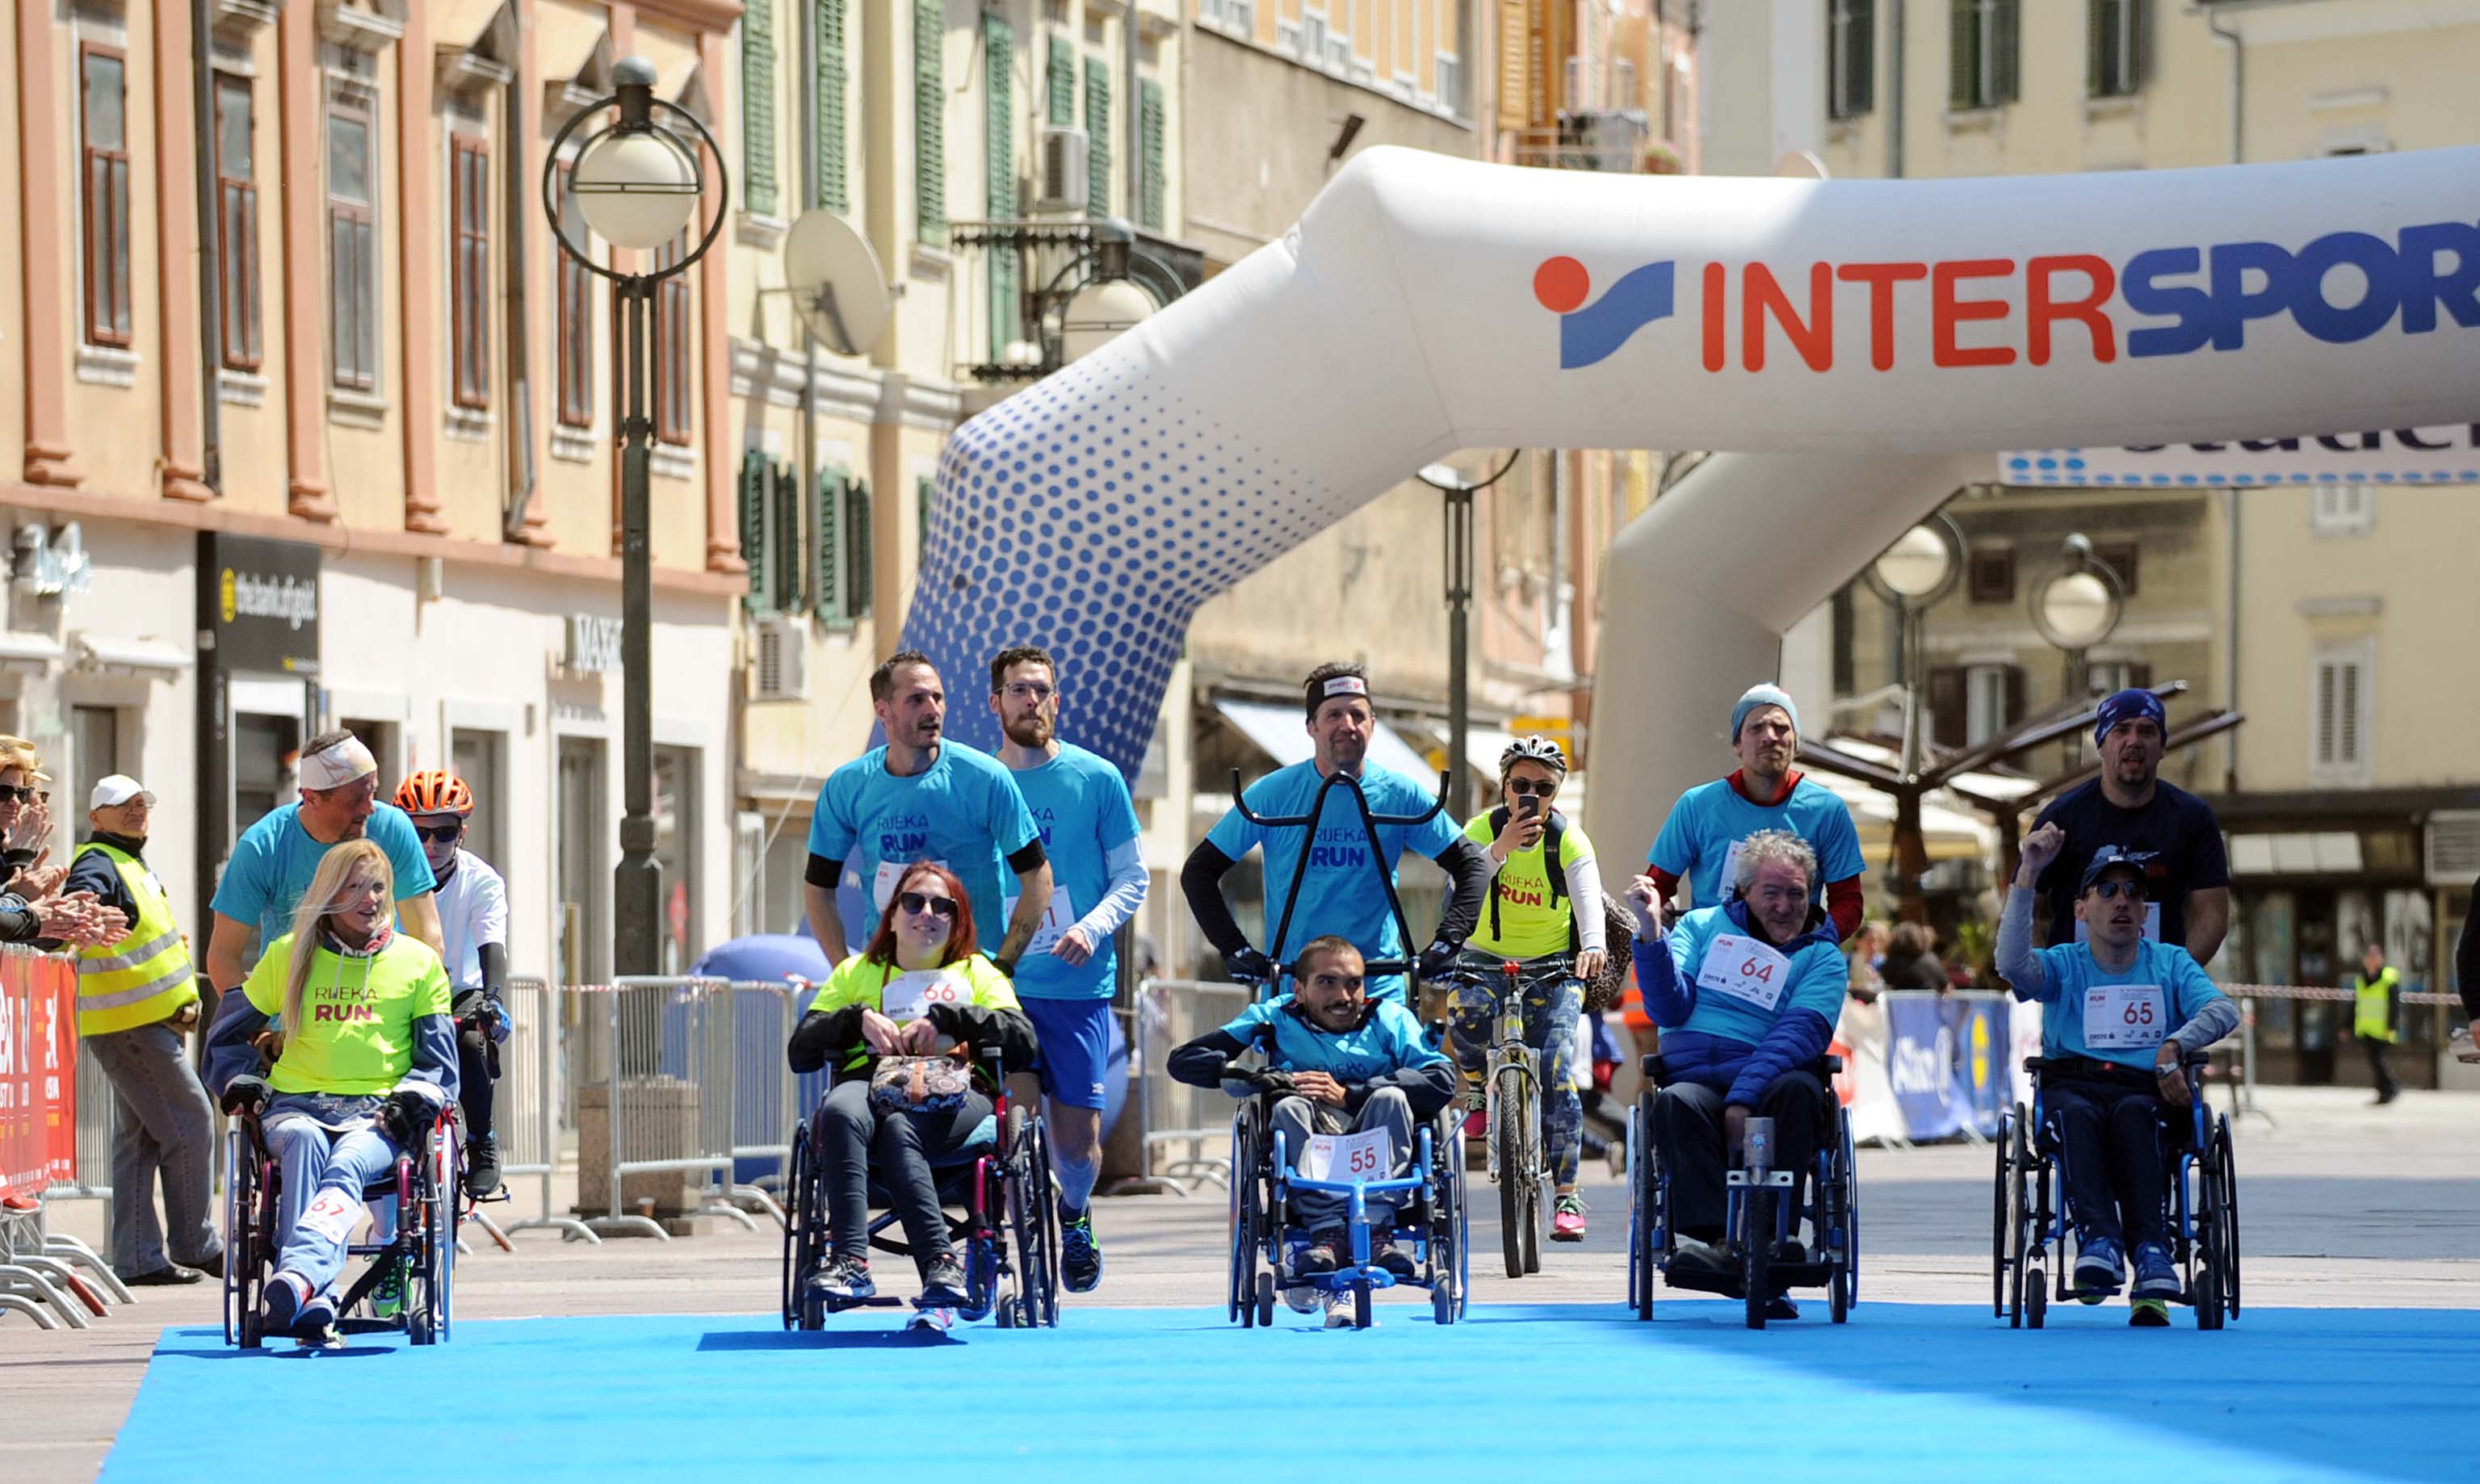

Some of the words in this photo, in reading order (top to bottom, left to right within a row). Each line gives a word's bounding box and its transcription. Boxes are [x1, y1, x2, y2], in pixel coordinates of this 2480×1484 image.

[1702, 220, 2480, 373] INTERSPOR
[877, 814, 929, 830] RIJEKA
[880, 832, 927, 853] RUN
[1316, 827, 1368, 841] RIJEKA
[1311, 845, 1366, 867] RUN
[1501, 872, 1544, 888] RIJEKA
[1500, 883, 1542, 906] RUN
[1741, 957, 1774, 983] 64
[315, 987, 378, 1000] RIJEKA
[924, 983, 956, 1002] 66
[315, 1004, 373, 1021] RUN
[2123, 1002, 2153, 1025] 65
[1350, 1146, 1377, 1173] 55
[311, 1197, 345, 1216] 67
